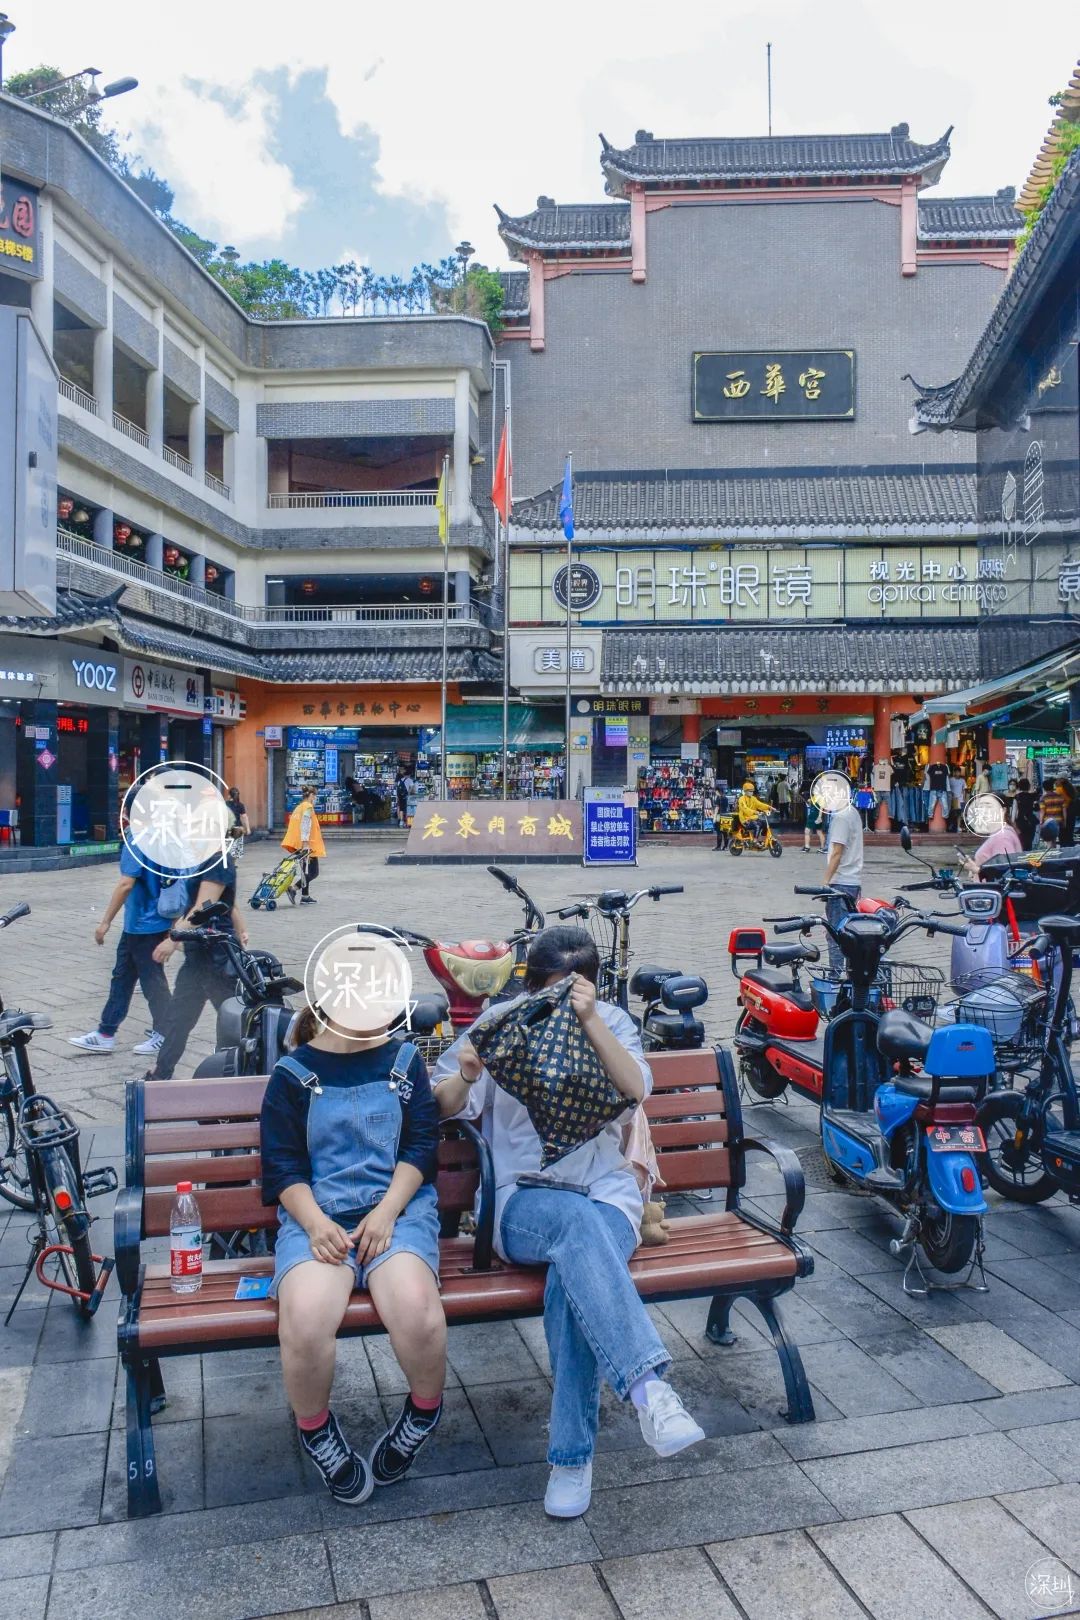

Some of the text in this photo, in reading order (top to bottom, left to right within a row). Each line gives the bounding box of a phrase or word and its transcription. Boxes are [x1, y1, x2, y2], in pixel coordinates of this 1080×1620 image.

[542, 649, 586, 670] 美瞳
[72, 659, 117, 692] YOOZ
[590, 821, 630, 833] 禁止停放单车
[590, 835, 630, 847] 违者拖走罚款
